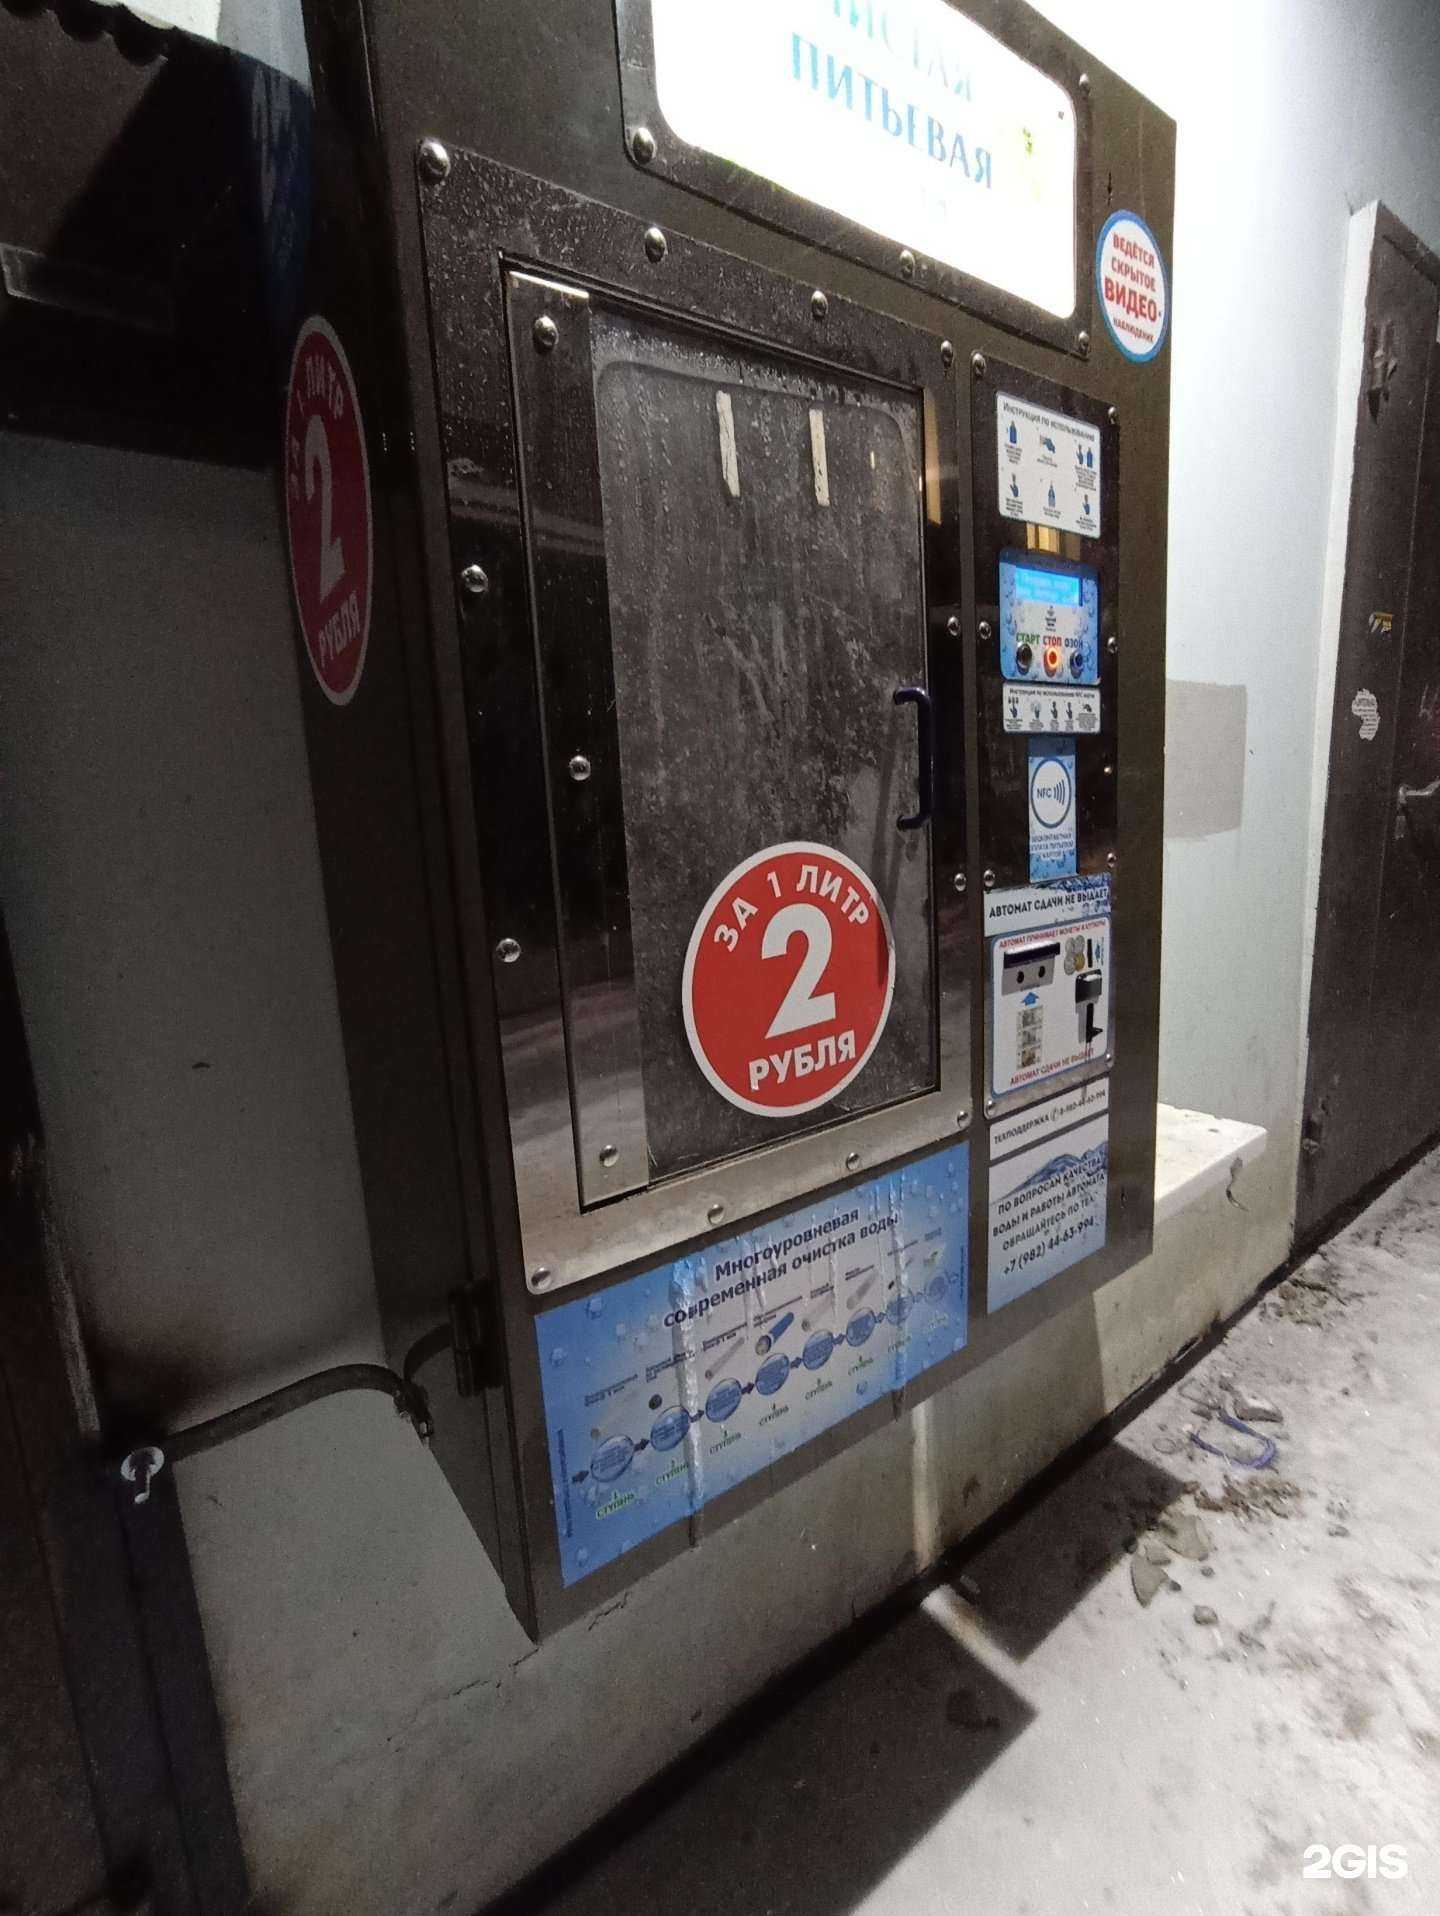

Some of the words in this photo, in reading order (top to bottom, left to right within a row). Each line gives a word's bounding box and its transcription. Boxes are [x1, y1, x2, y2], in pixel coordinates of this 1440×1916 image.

[791, 31, 992, 189] ПИТЬЕВАЯ
[1111, 256, 1156, 292] СКРЫТОЕ
[1113, 232, 1154, 269] ВЕДЁТСЯ
[1104, 276, 1162, 322] ВИДЕО-
[305, 355, 343, 420] ЛИТР
[304, 414, 346, 605] 2
[318, 591, 360, 669] РУБЛЯ
[1016, 632, 1040, 645] СТАРТ
[1042, 635, 1062, 647] СТОП
[1037, 787, 1052, 798] NFC
[713, 896, 758, 953] ЗА
[767, 871, 781, 898] 1
[796, 864, 870, 926] ЛИТР
[989, 900, 1032, 919] АВТОМАТ
[1034, 897, 1064, 910] СДАЧИ
[1065, 894, 1076, 905] НЕ
[1076, 887, 1108, 902] ВЫДАЕТ
[760, 901, 836, 1040] 2
[748, 1030, 856, 1093] РУБЛЯ
[994, 1114, 1049, 1144] ТЕХПОДДЕРЖКА
[993, 1218, 1020, 1237] ВОДЫ
[1022, 1211, 1029, 1223] И
[1030, 1194, 1065, 1218] РАБОТЫ
[1066, 1173, 1105, 1198] АВТОМАТА
[998, 1200, 1012, 1215] ПО
[1013, 1178, 1062, 1208] ВОПРОСАМ
[1063, 1158, 1101, 1183] КАЧЕСТВА
[713, 1208, 861, 1282] Многоуровневая
[1002, 1211, 1066, 1251] ОБРАЩАЙТЕСЬ
[1067, 1203, 1079, 1216] ПО
[663, 1263, 788, 1328] современная
[791, 1232, 856, 1272] очистка
[859, 1211, 901, 1244] воды
[1003, 1259, 1016, 1275] +7
[1018, 1242, 1045, 1270] (982)
